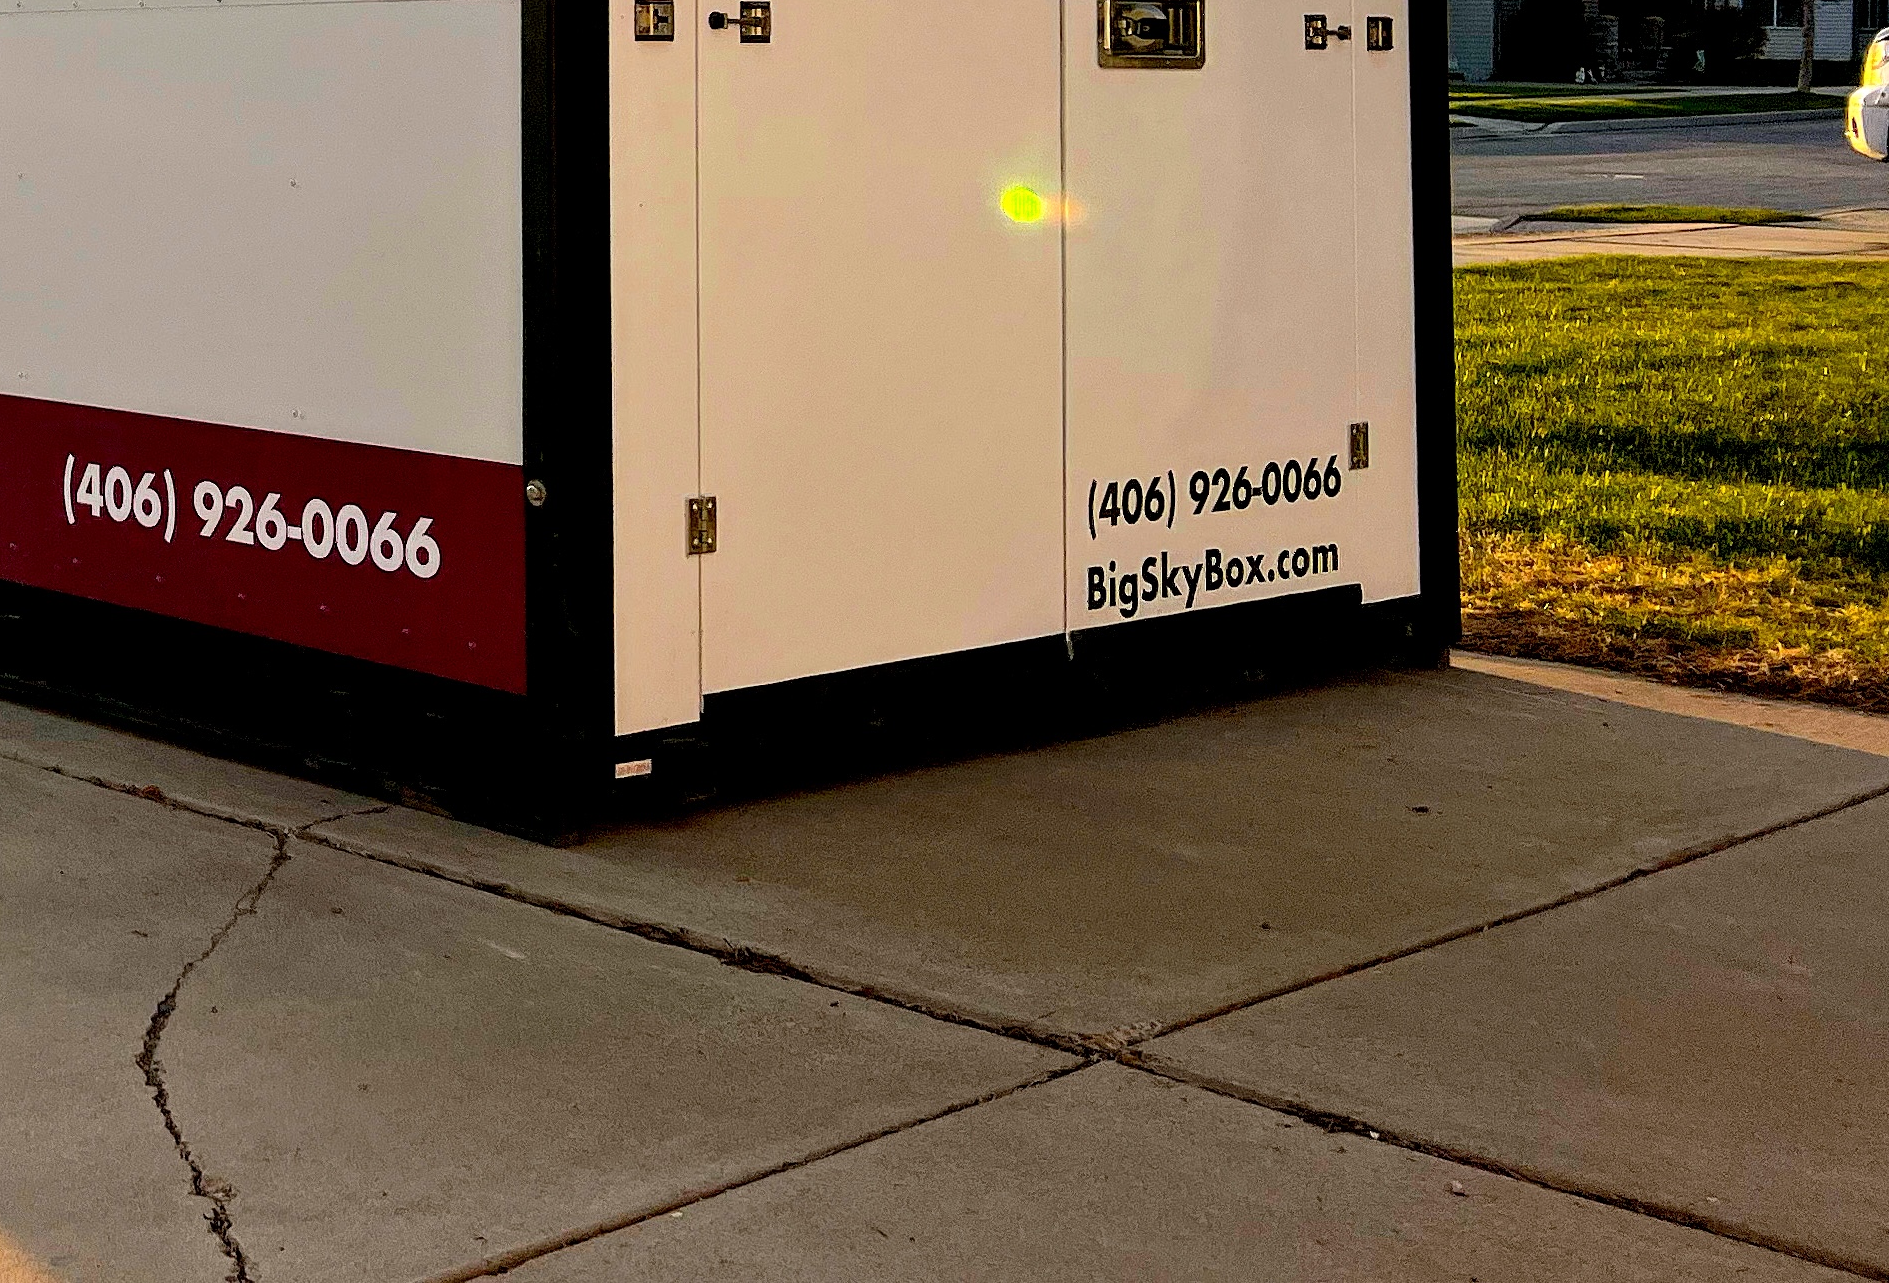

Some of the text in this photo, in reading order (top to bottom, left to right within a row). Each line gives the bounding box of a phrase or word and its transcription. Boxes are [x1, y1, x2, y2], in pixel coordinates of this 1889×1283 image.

[63, 452, 442, 580] (406) 926-0066
[1087, 454, 1342, 540] (406) 926-0066
[1087, 541, 1339, 619] BigSkyBox.com
